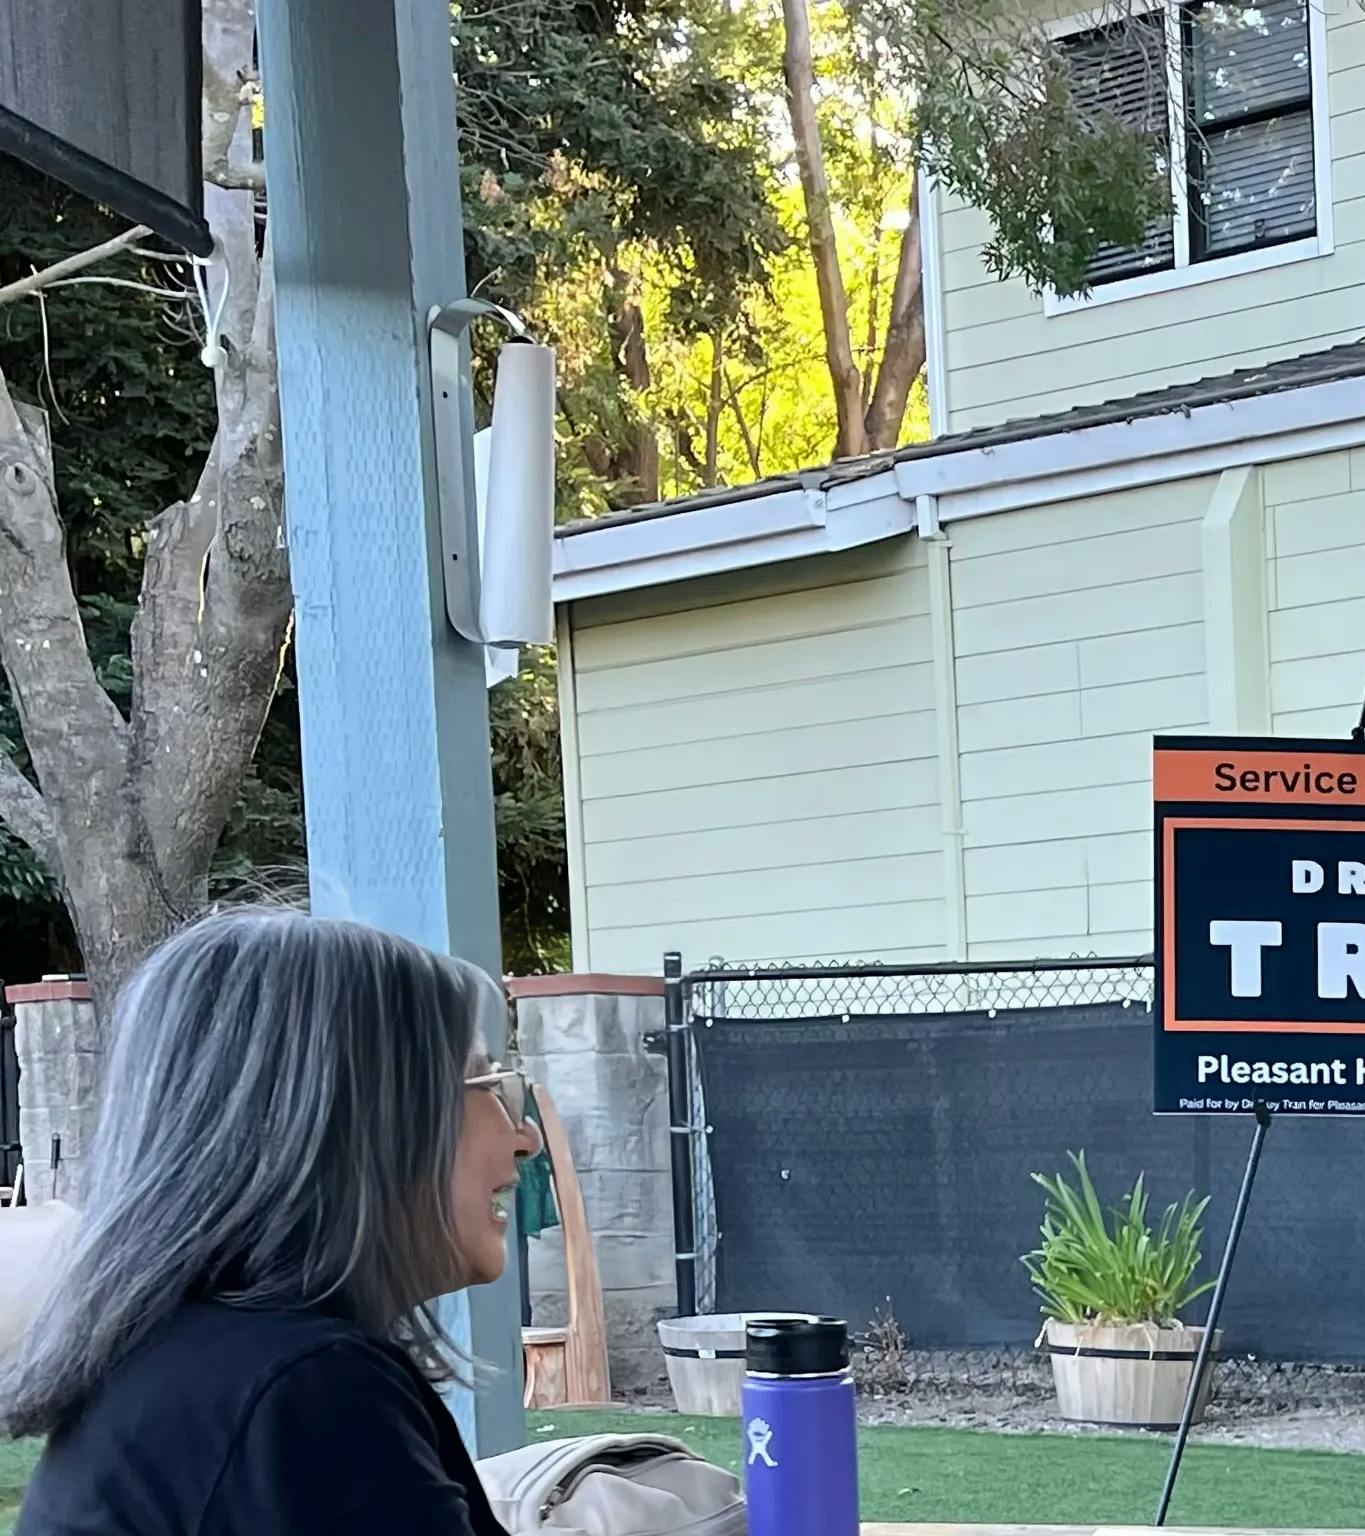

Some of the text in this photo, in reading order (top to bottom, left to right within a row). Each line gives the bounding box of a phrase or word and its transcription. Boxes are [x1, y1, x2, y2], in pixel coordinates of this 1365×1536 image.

[1214, 762, 1358, 795] Service
[1197, 1054, 1347, 1086] Pleasant
[1179, 1098, 1204, 1109] Paid
[1206, 1098, 1222, 1109] for
[1224, 1098, 1239, 1111] by
[1282, 1099, 1306, 1110] Tran
[1308, 1099, 1325, 1110] for
